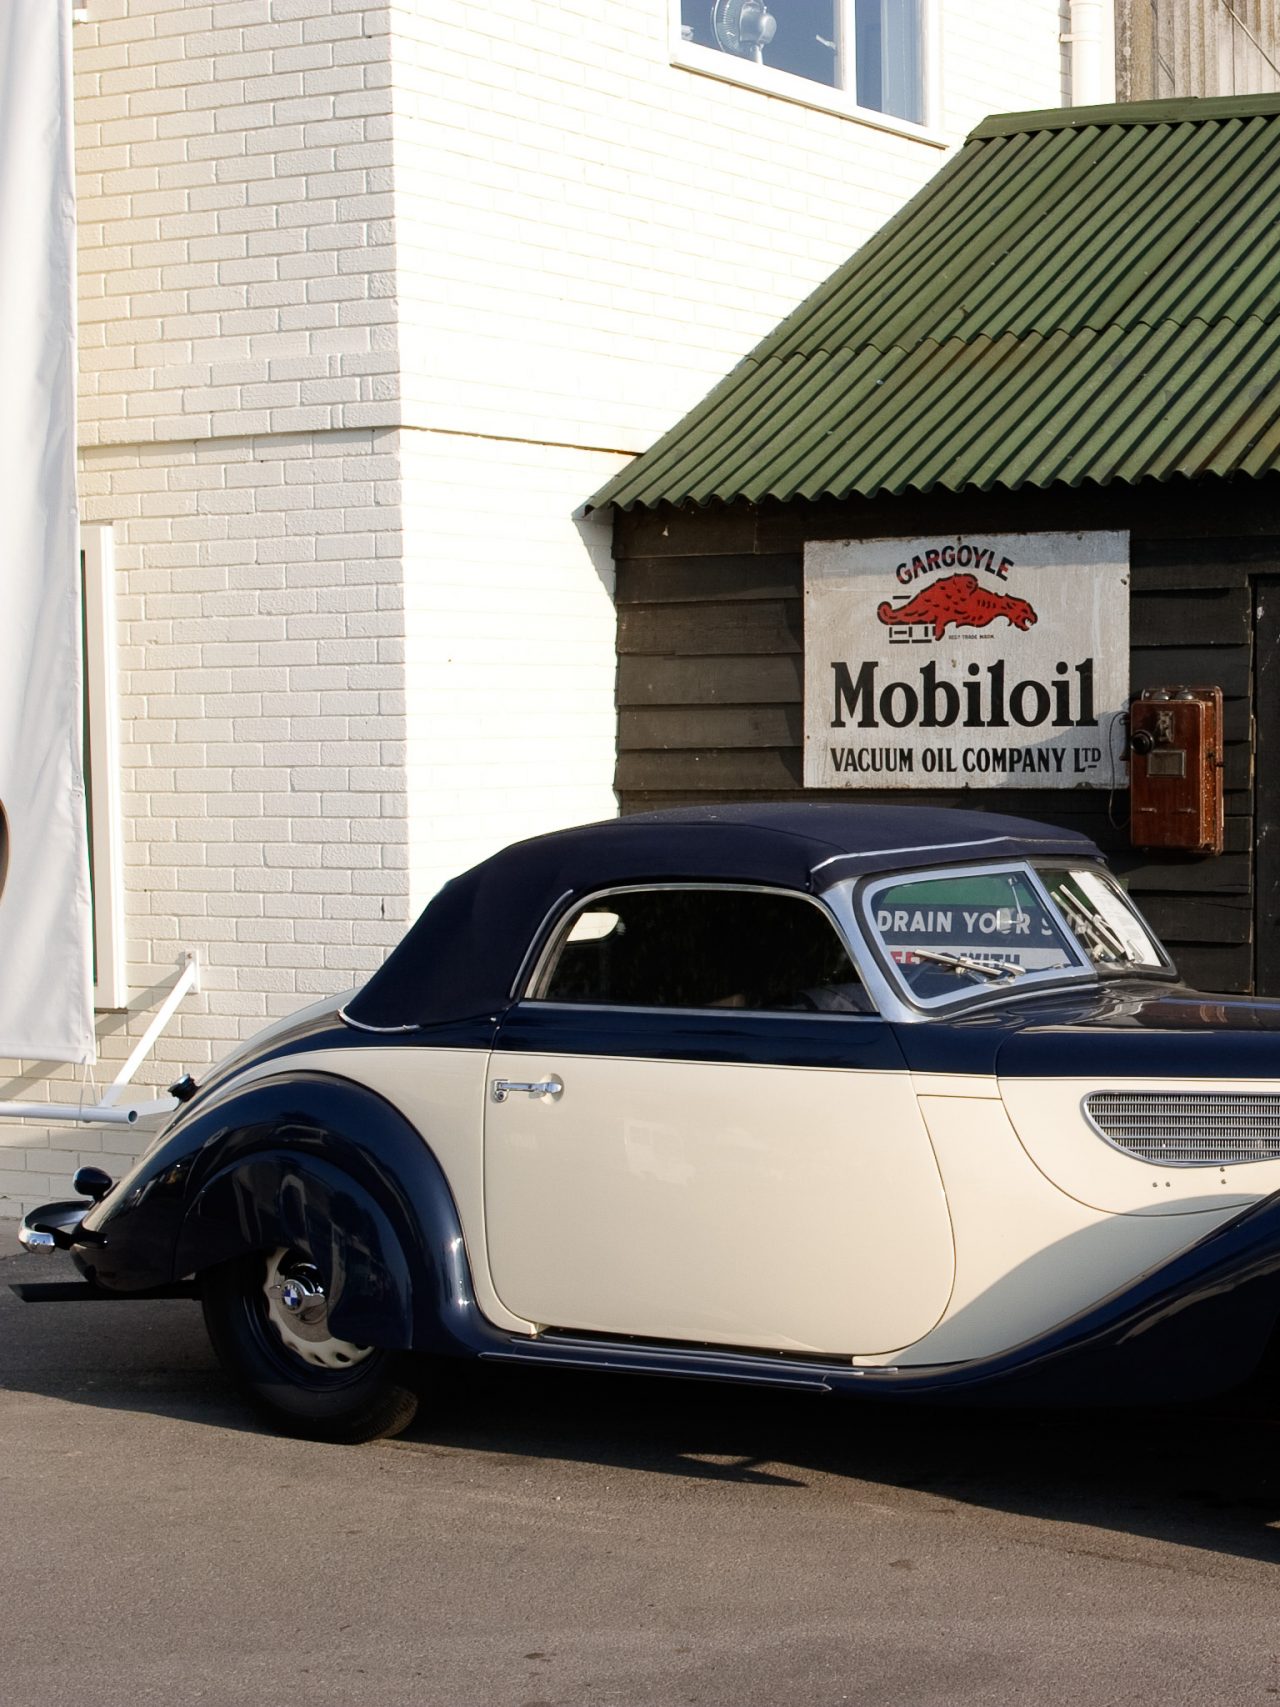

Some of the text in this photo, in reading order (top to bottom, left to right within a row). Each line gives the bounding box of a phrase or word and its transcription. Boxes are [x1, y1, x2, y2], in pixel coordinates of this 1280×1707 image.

[895, 545, 1015, 585] GARGOYLE
[830, 658, 1099, 728] Mobiloil
[830, 748, 914, 773] VACUUM
[922, 748, 957, 773] OIL
[962, 748, 1067, 773] COMPANY
[877, 910, 953, 932] DRAIN
